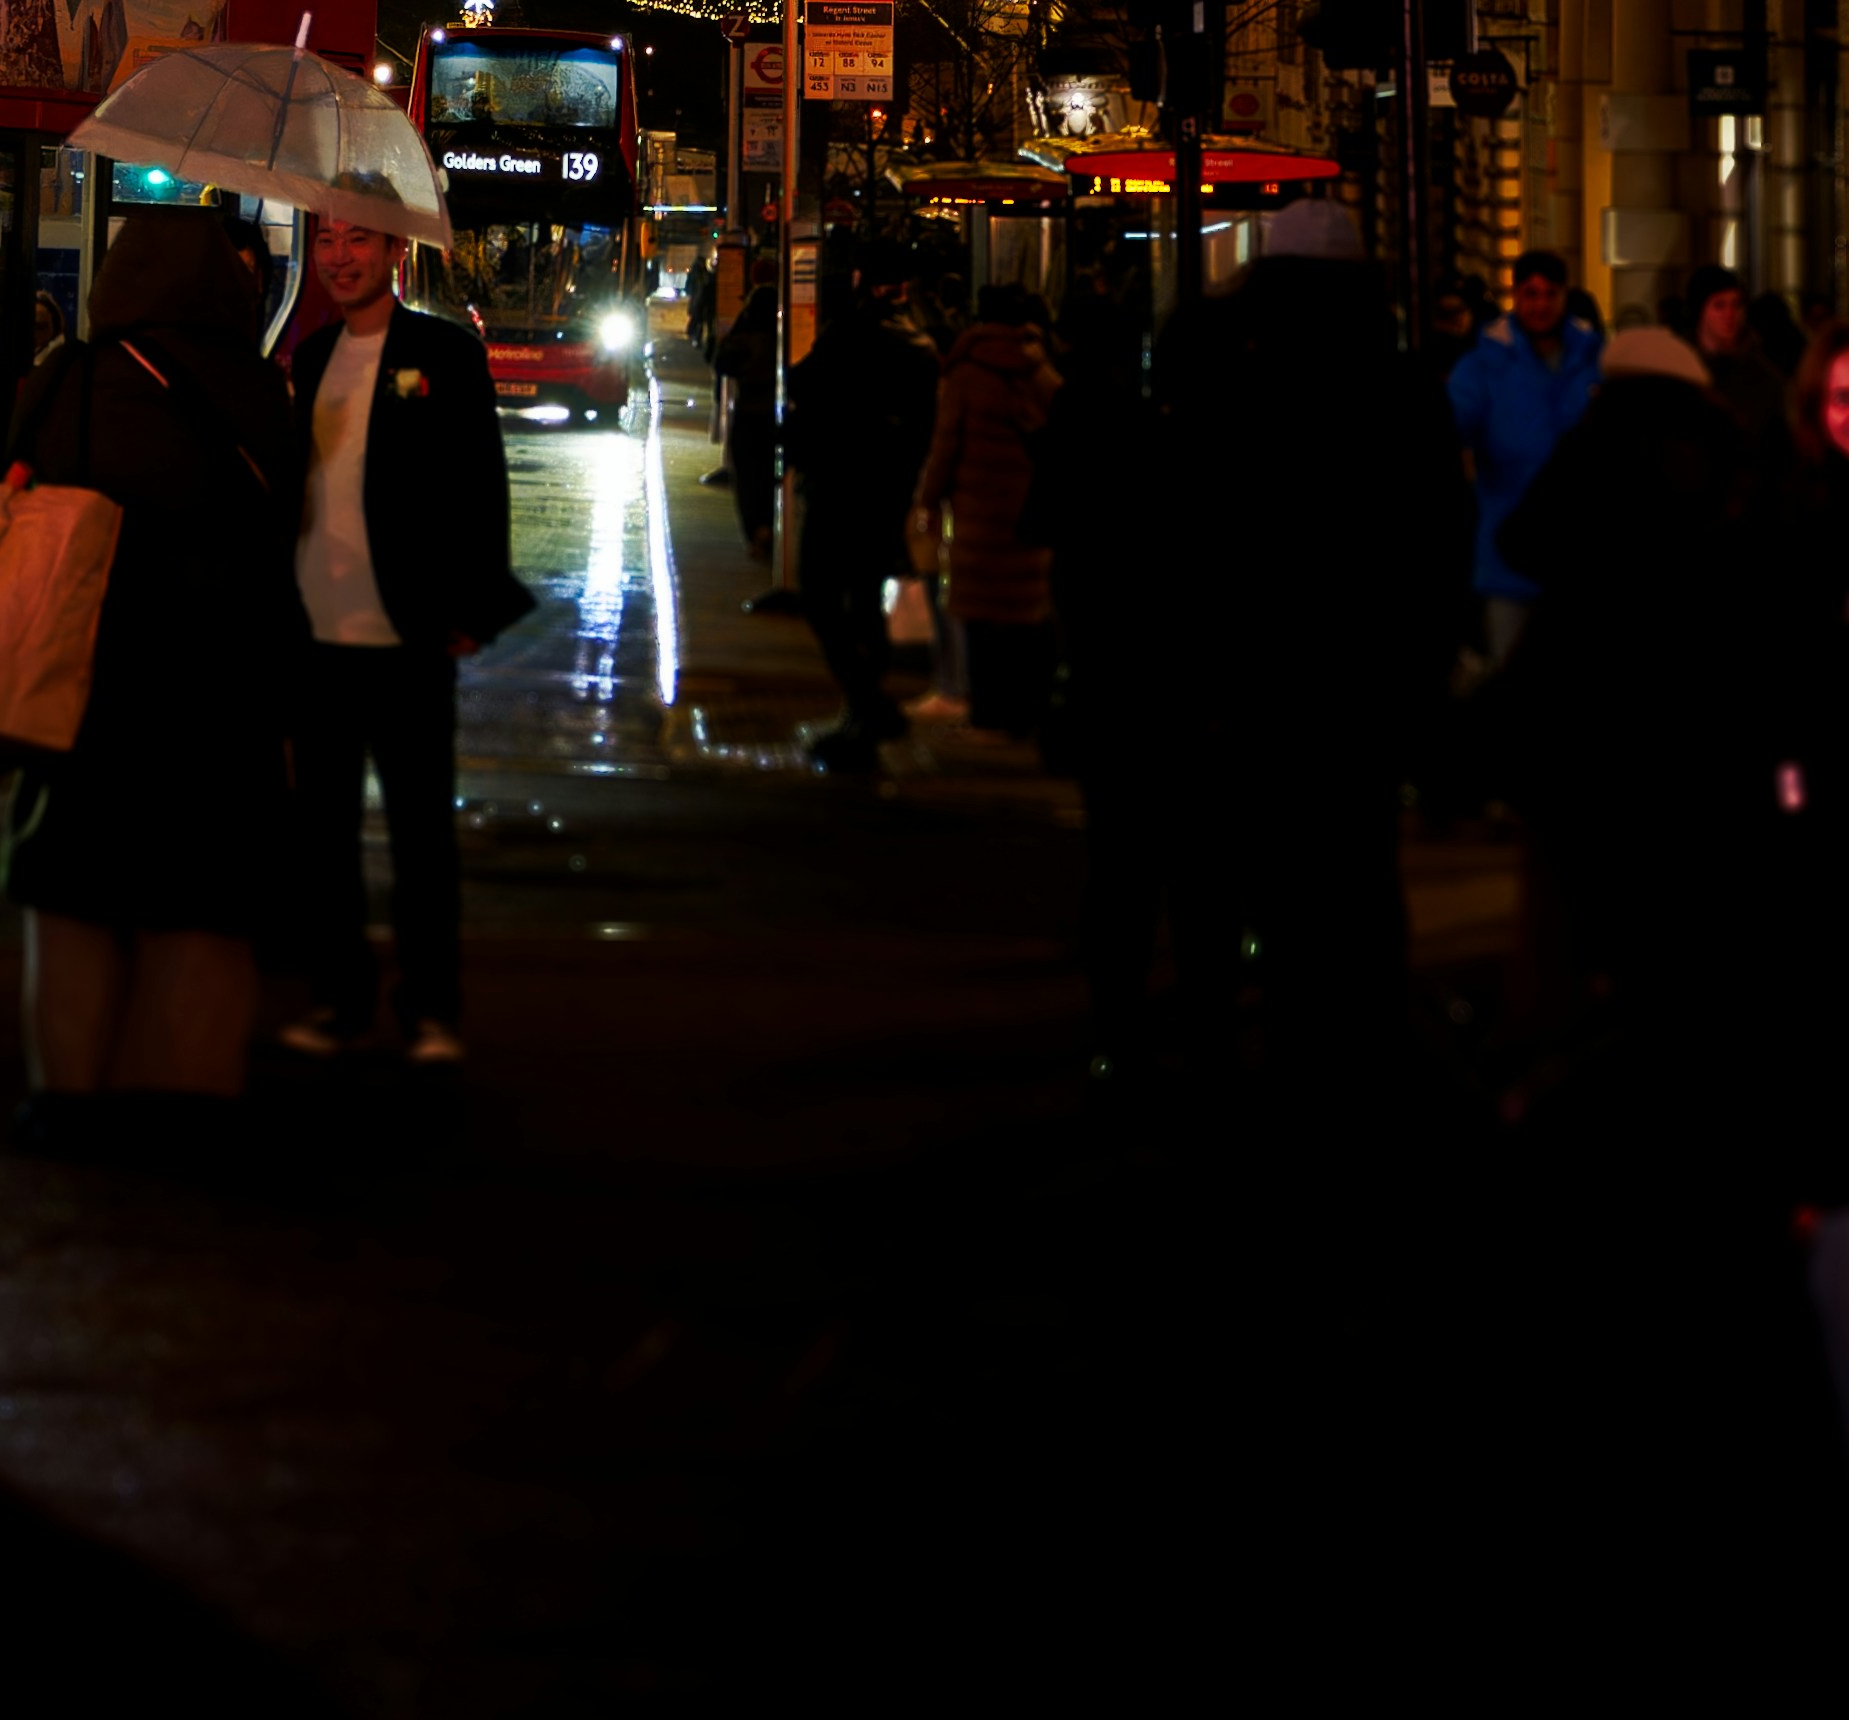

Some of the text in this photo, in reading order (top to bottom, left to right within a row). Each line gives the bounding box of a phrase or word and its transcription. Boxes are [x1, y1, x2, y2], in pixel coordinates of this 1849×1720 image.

[823, 5, 877, 15] Regent Street
[728, 15, 746, 37] Z
[813, 58, 825, 68] 12
[842, 58, 856, 68] 88
[871, 59, 884, 68] 94
[810, 83, 829, 92] 453
[841, 83, 856, 92] N3
[867, 83, 888, 93] N15
[443, 151, 541, 174] Golders Green
[562, 152, 599, 181] 139
